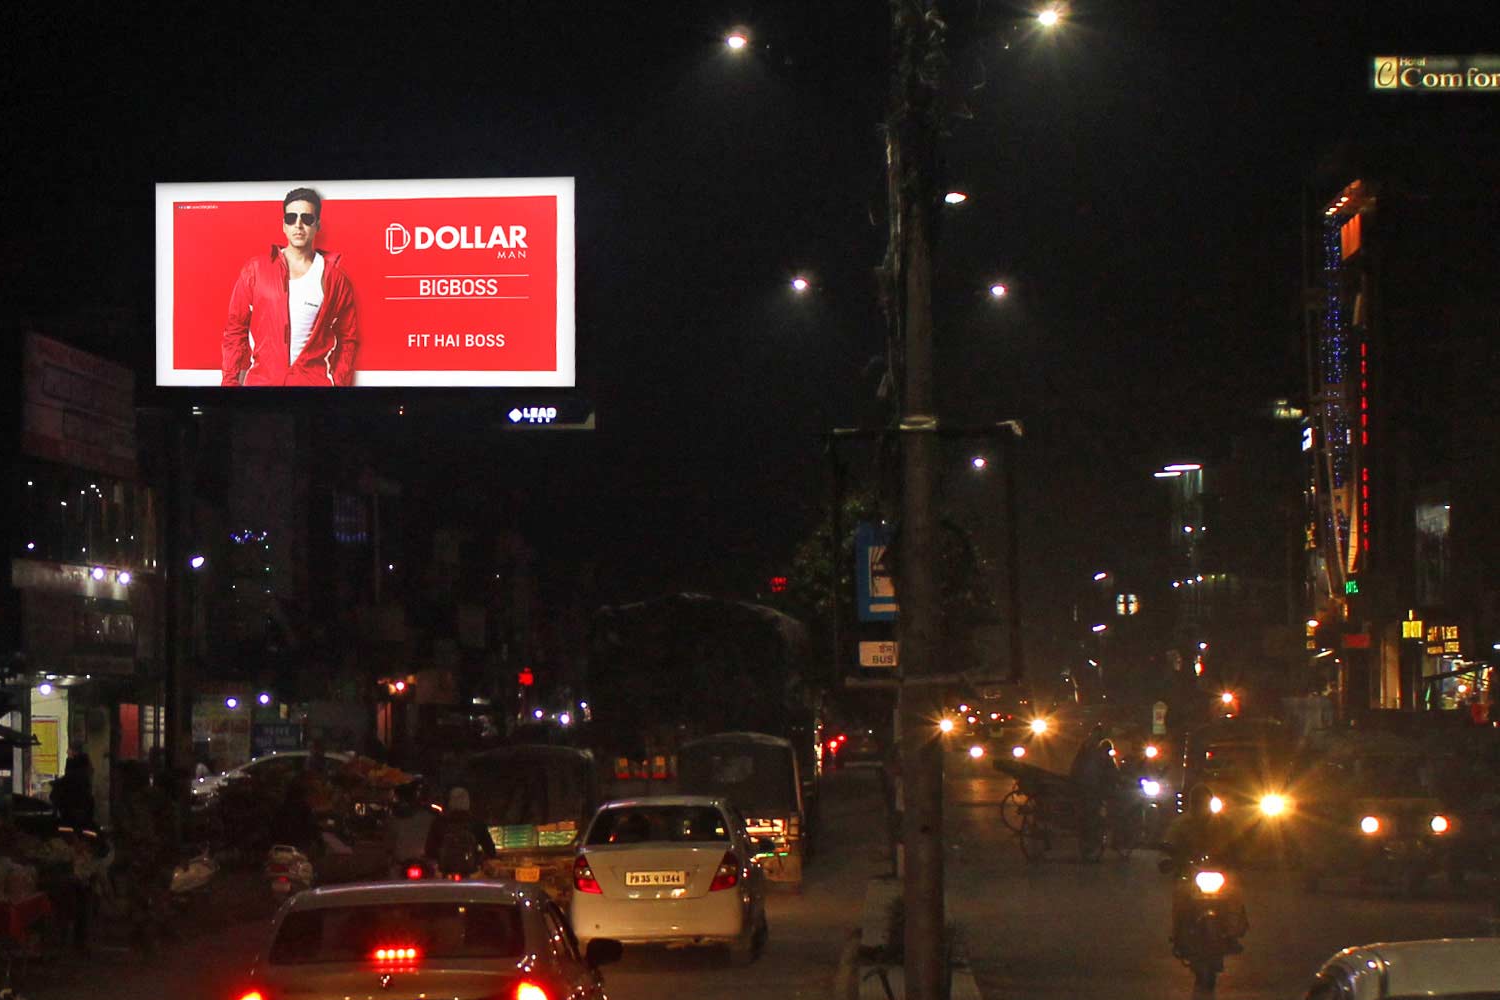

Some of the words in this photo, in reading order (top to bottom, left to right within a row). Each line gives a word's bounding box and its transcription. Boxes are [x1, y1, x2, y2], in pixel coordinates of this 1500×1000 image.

[414, 225, 528, 250] DOLLAR
[496, 250, 527, 259] MAN
[419, 279, 498, 296] BIGBOSS
[407, 334, 431, 348] FIT
[434, 334, 460, 348] HAI
[464, 334, 506, 348] BOSS
[523, 407, 557, 418] LEAD
